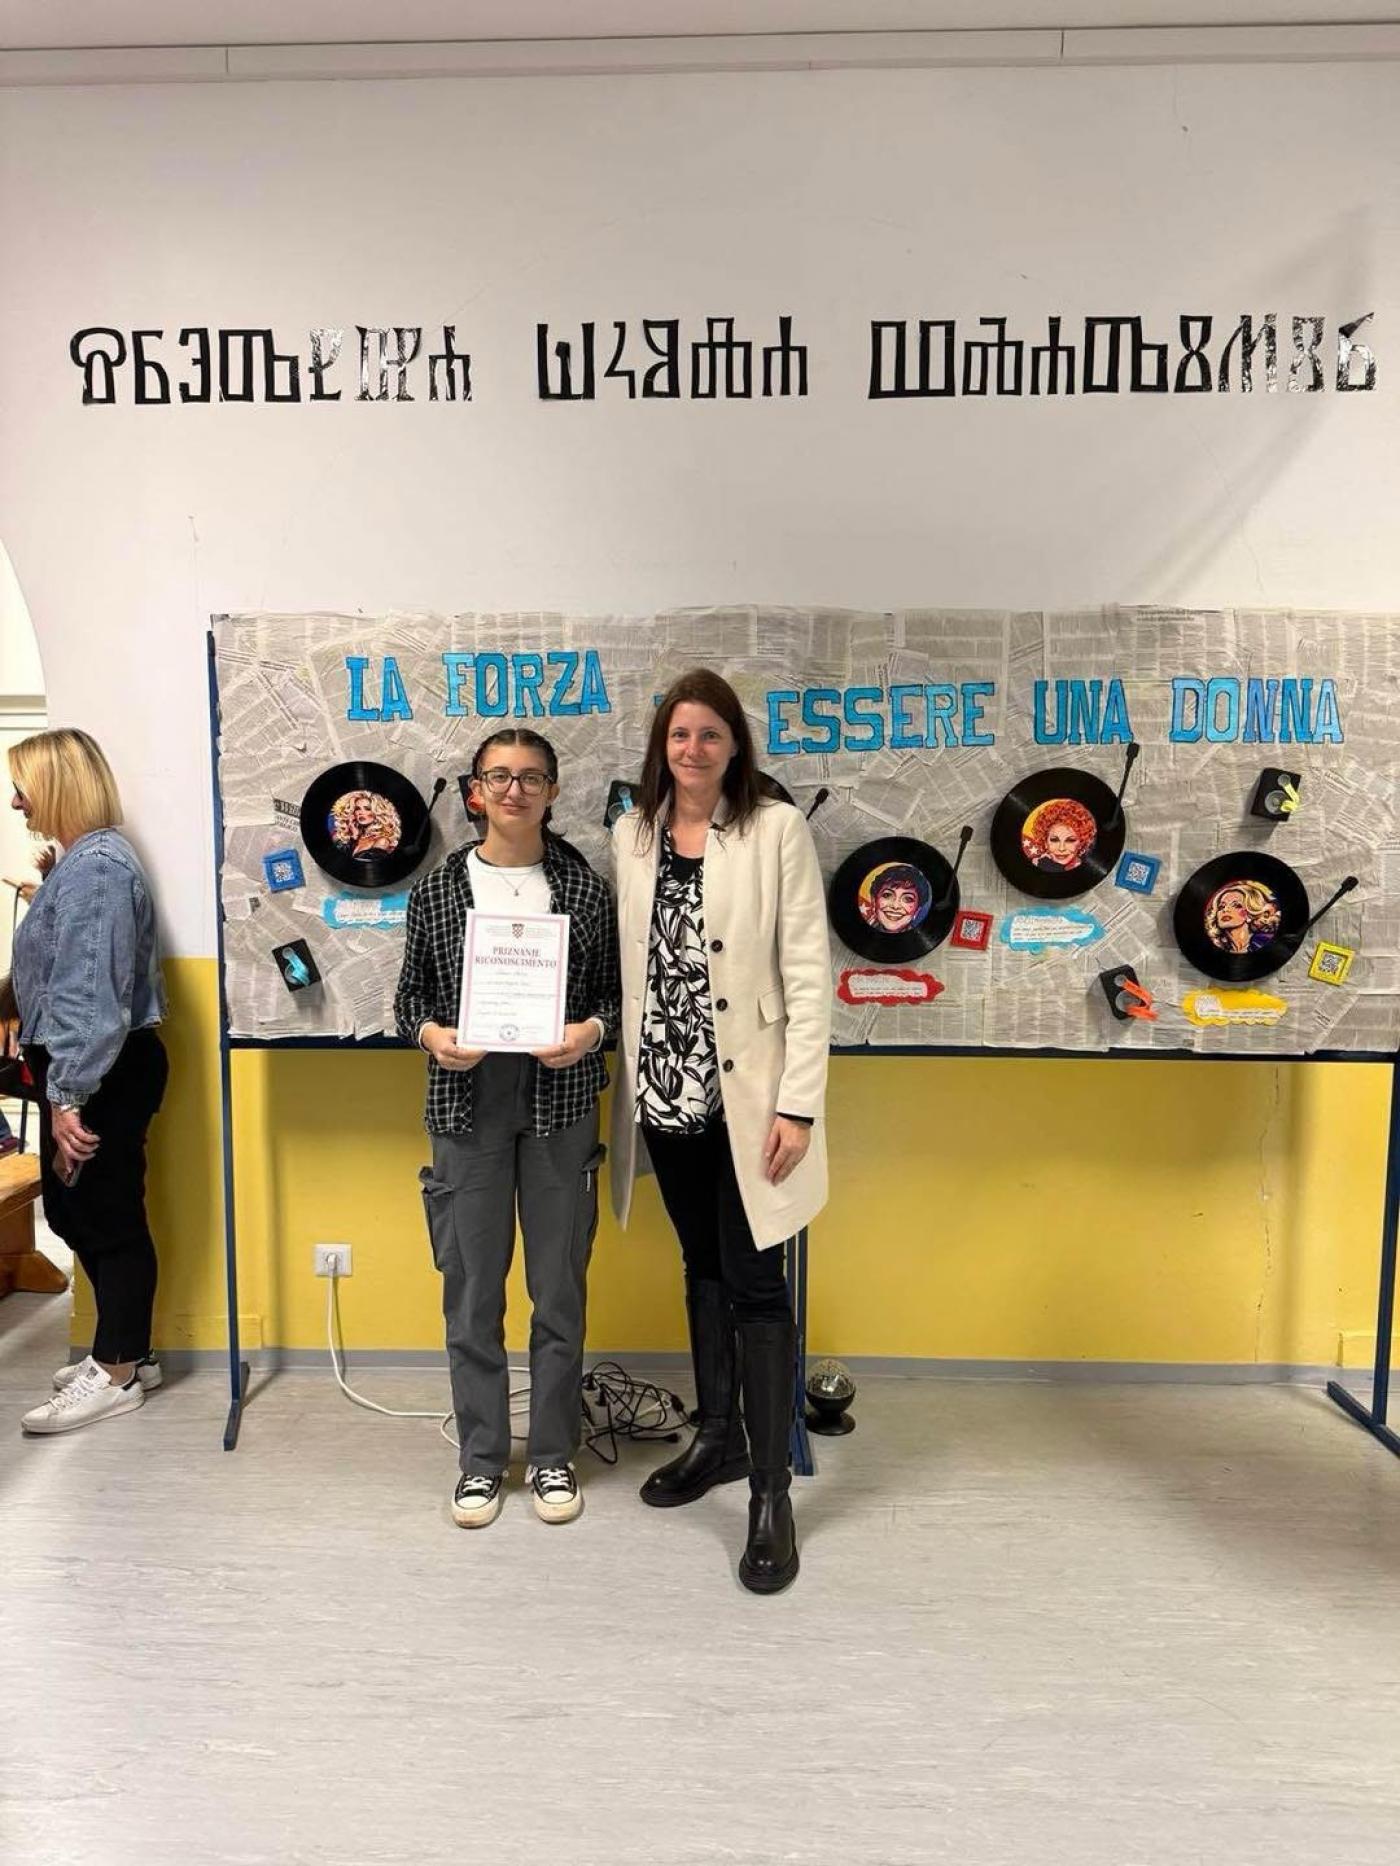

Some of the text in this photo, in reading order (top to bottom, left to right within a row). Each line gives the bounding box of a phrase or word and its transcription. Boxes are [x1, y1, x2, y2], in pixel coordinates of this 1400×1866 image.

[345, 649, 1345, 756] LA FORZA ESSERE UNA DONNA
[492, 946, 541, 957] PRIZNANJE
[474, 956, 557, 968] RICONOSCIMENTO
